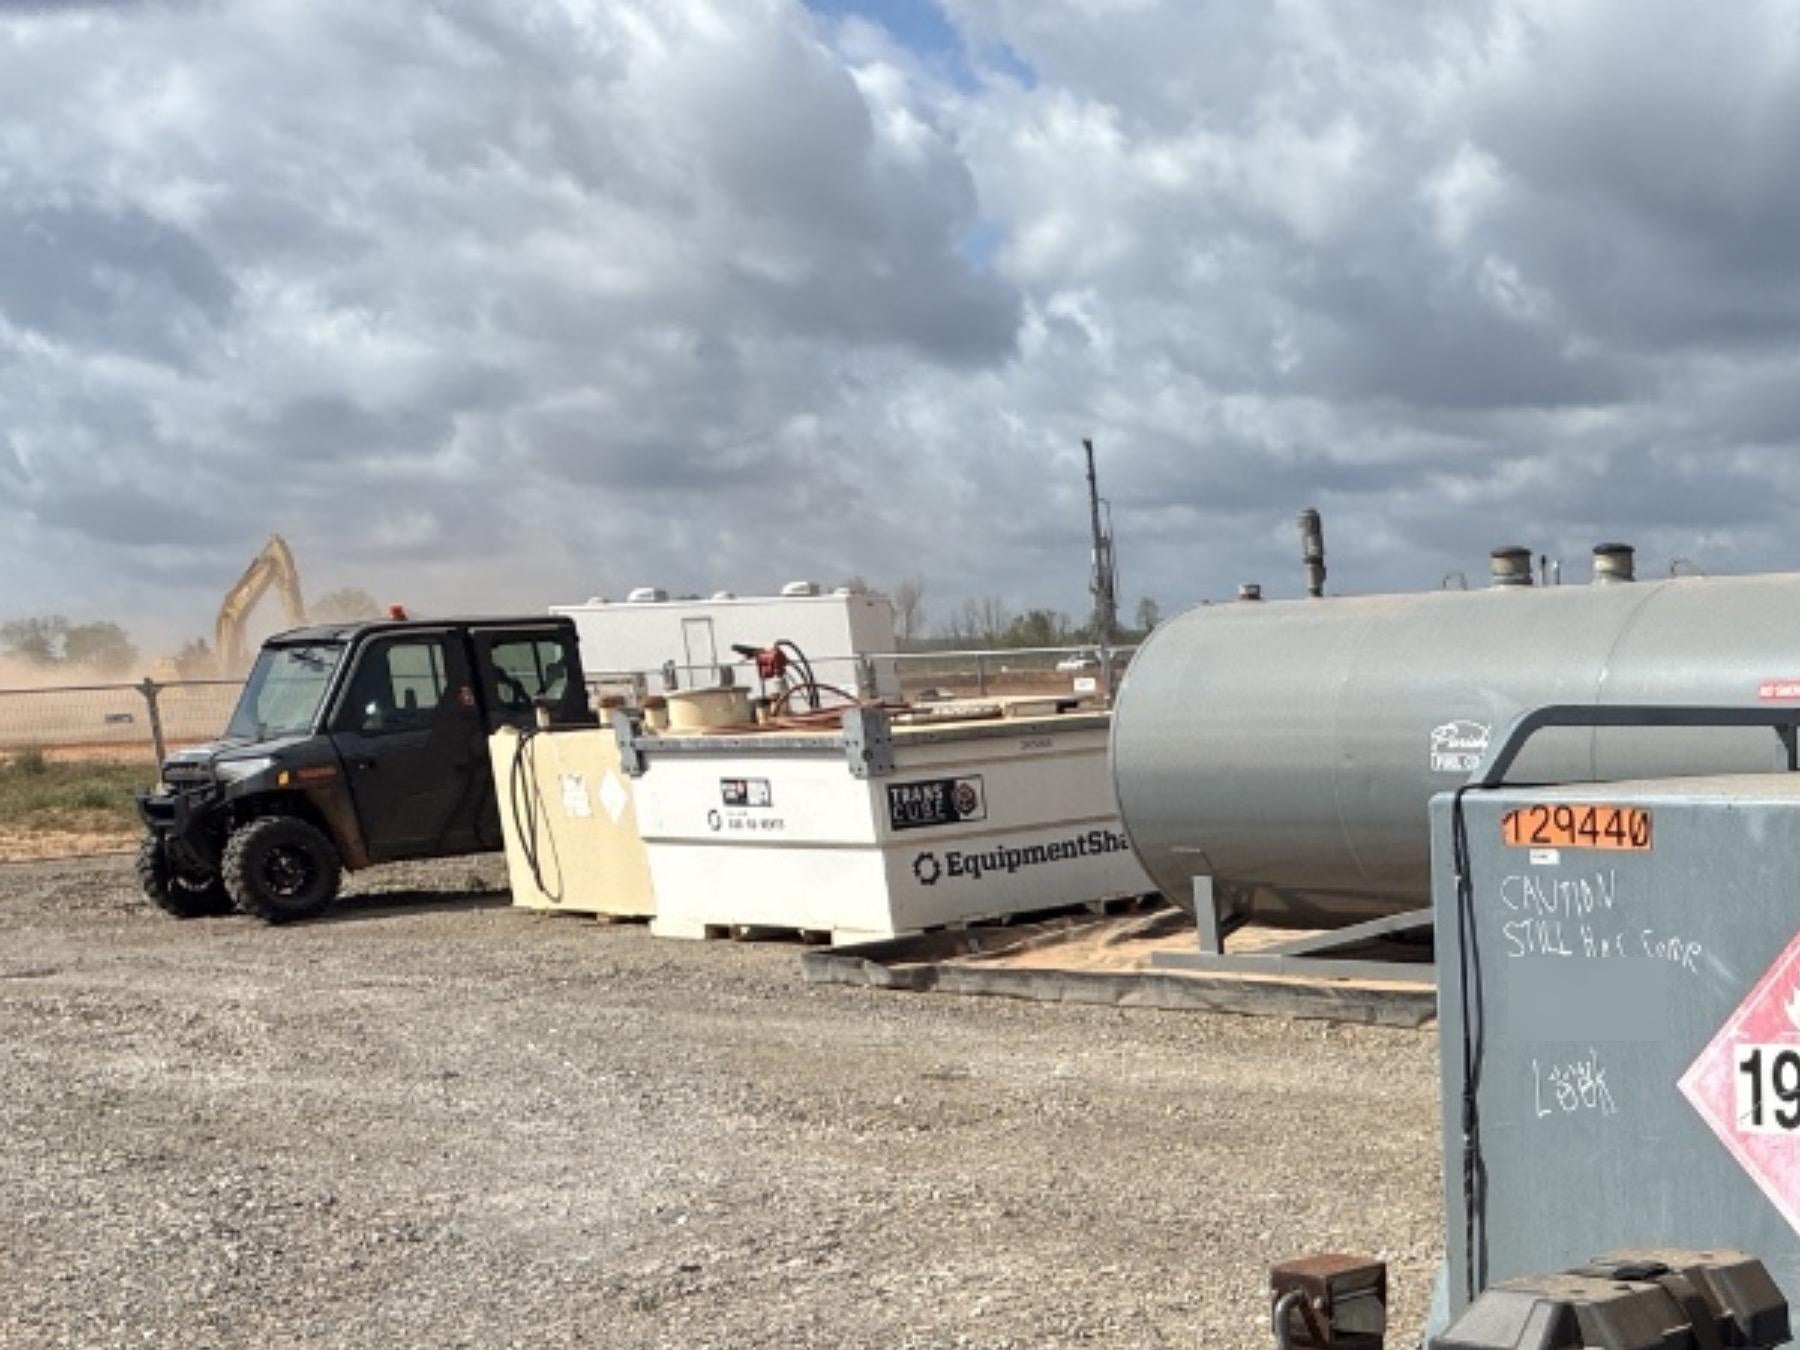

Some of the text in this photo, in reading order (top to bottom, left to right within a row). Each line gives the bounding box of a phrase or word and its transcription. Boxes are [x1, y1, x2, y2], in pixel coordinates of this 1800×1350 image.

[890, 784, 945, 803] TRANS
[1502, 804, 1650, 848] 129440
[1500, 868, 1615, 918] CAUTION
